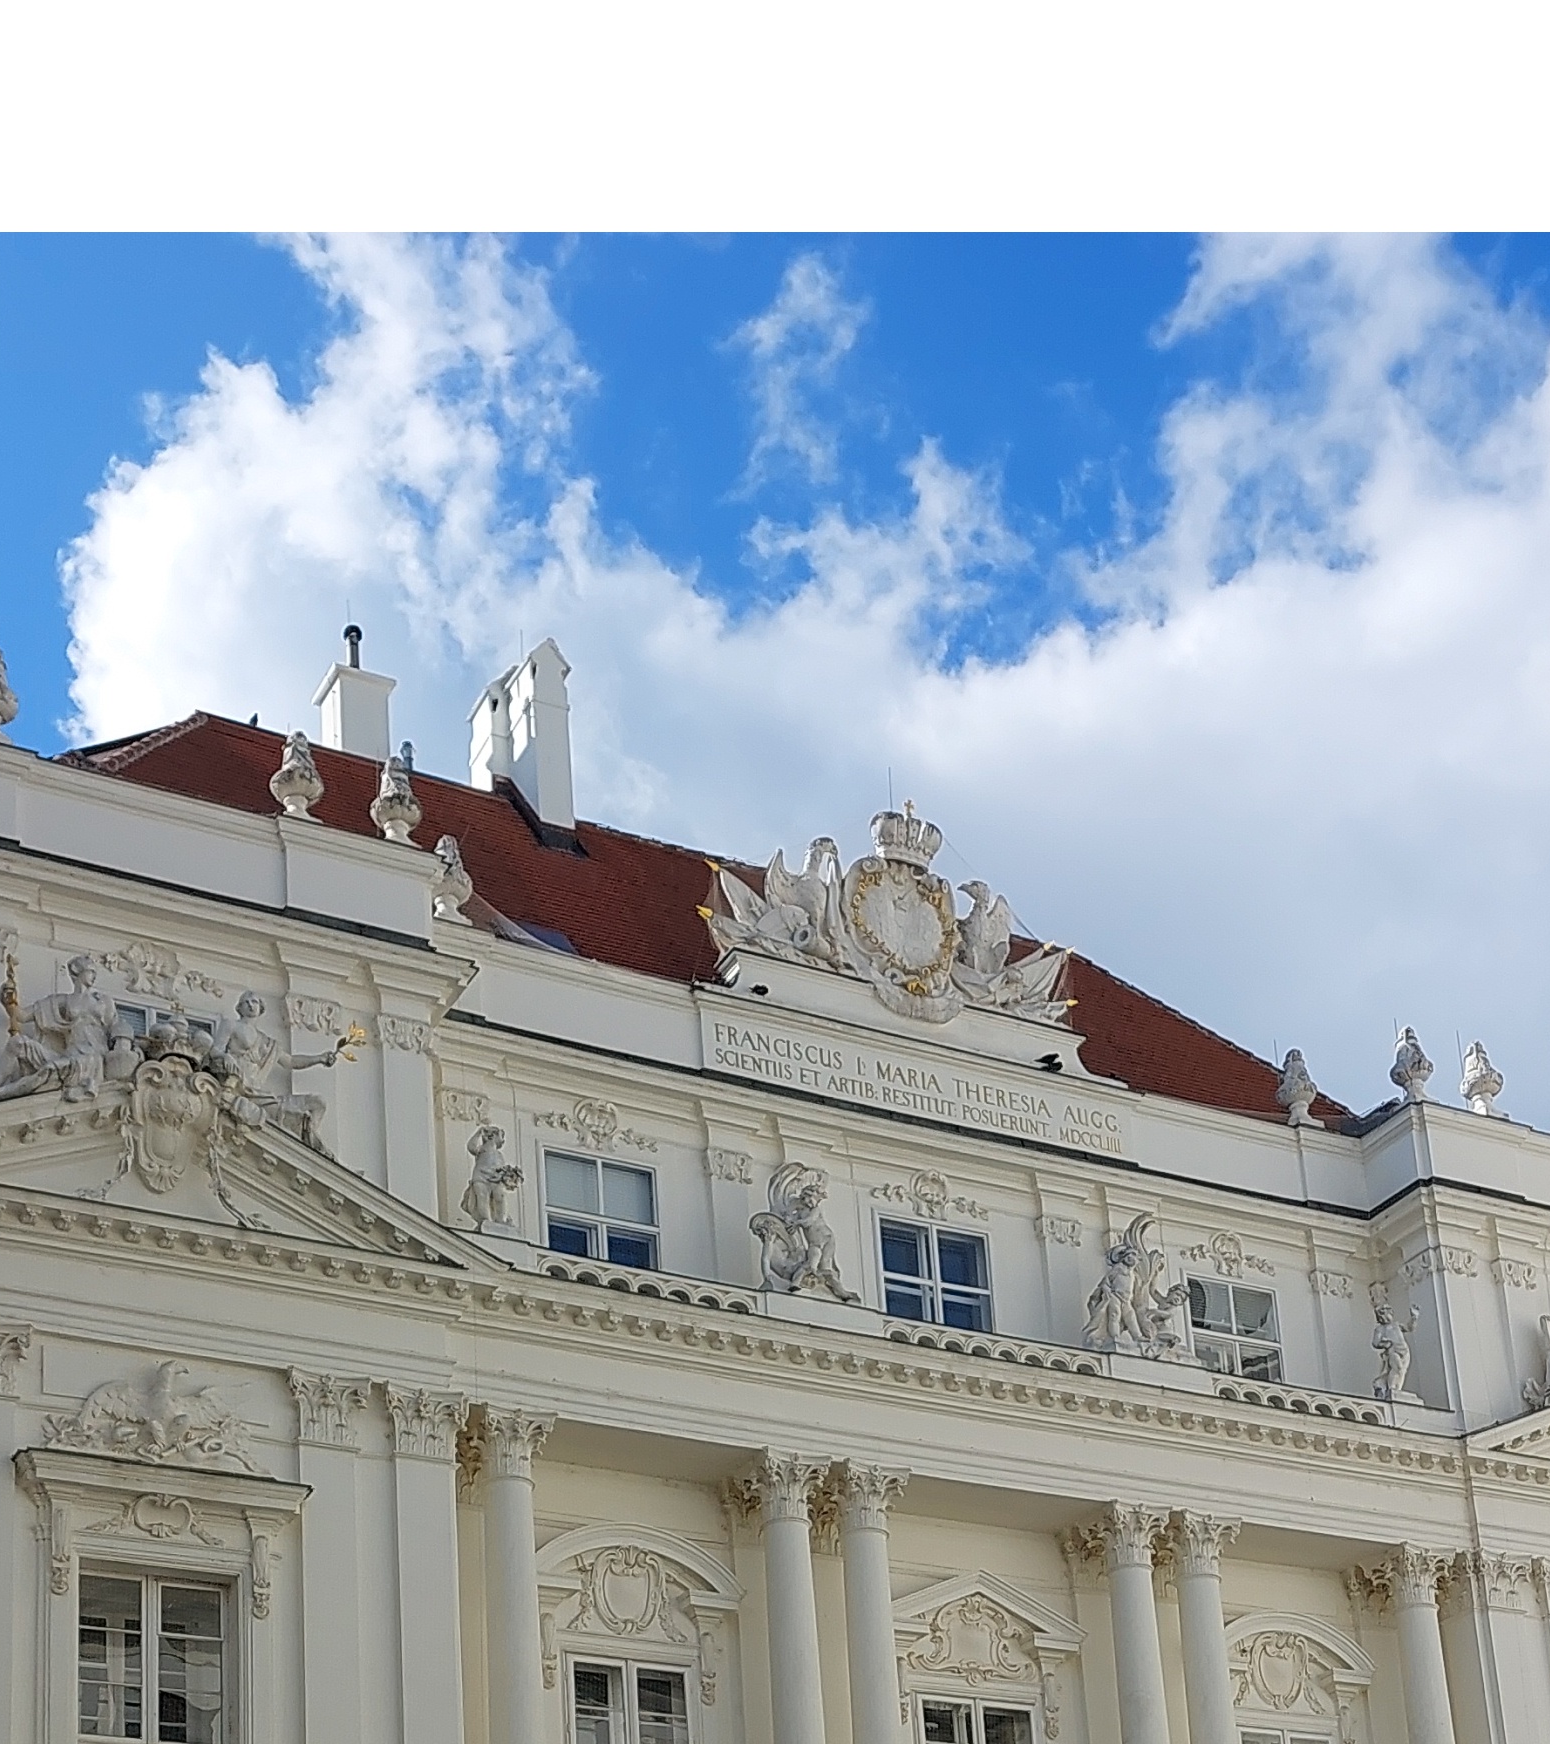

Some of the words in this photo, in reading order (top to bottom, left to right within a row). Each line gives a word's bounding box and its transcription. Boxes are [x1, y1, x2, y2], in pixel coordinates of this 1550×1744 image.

[714, 1022, 843, 1070] FRANCISCUS
[876, 1060, 943, 1094] MARIA
[952, 1077, 1052, 1119] THERESIA
[715, 1048, 793, 1080] SCIENTIIS
[800, 1067, 821, 1086] ET
